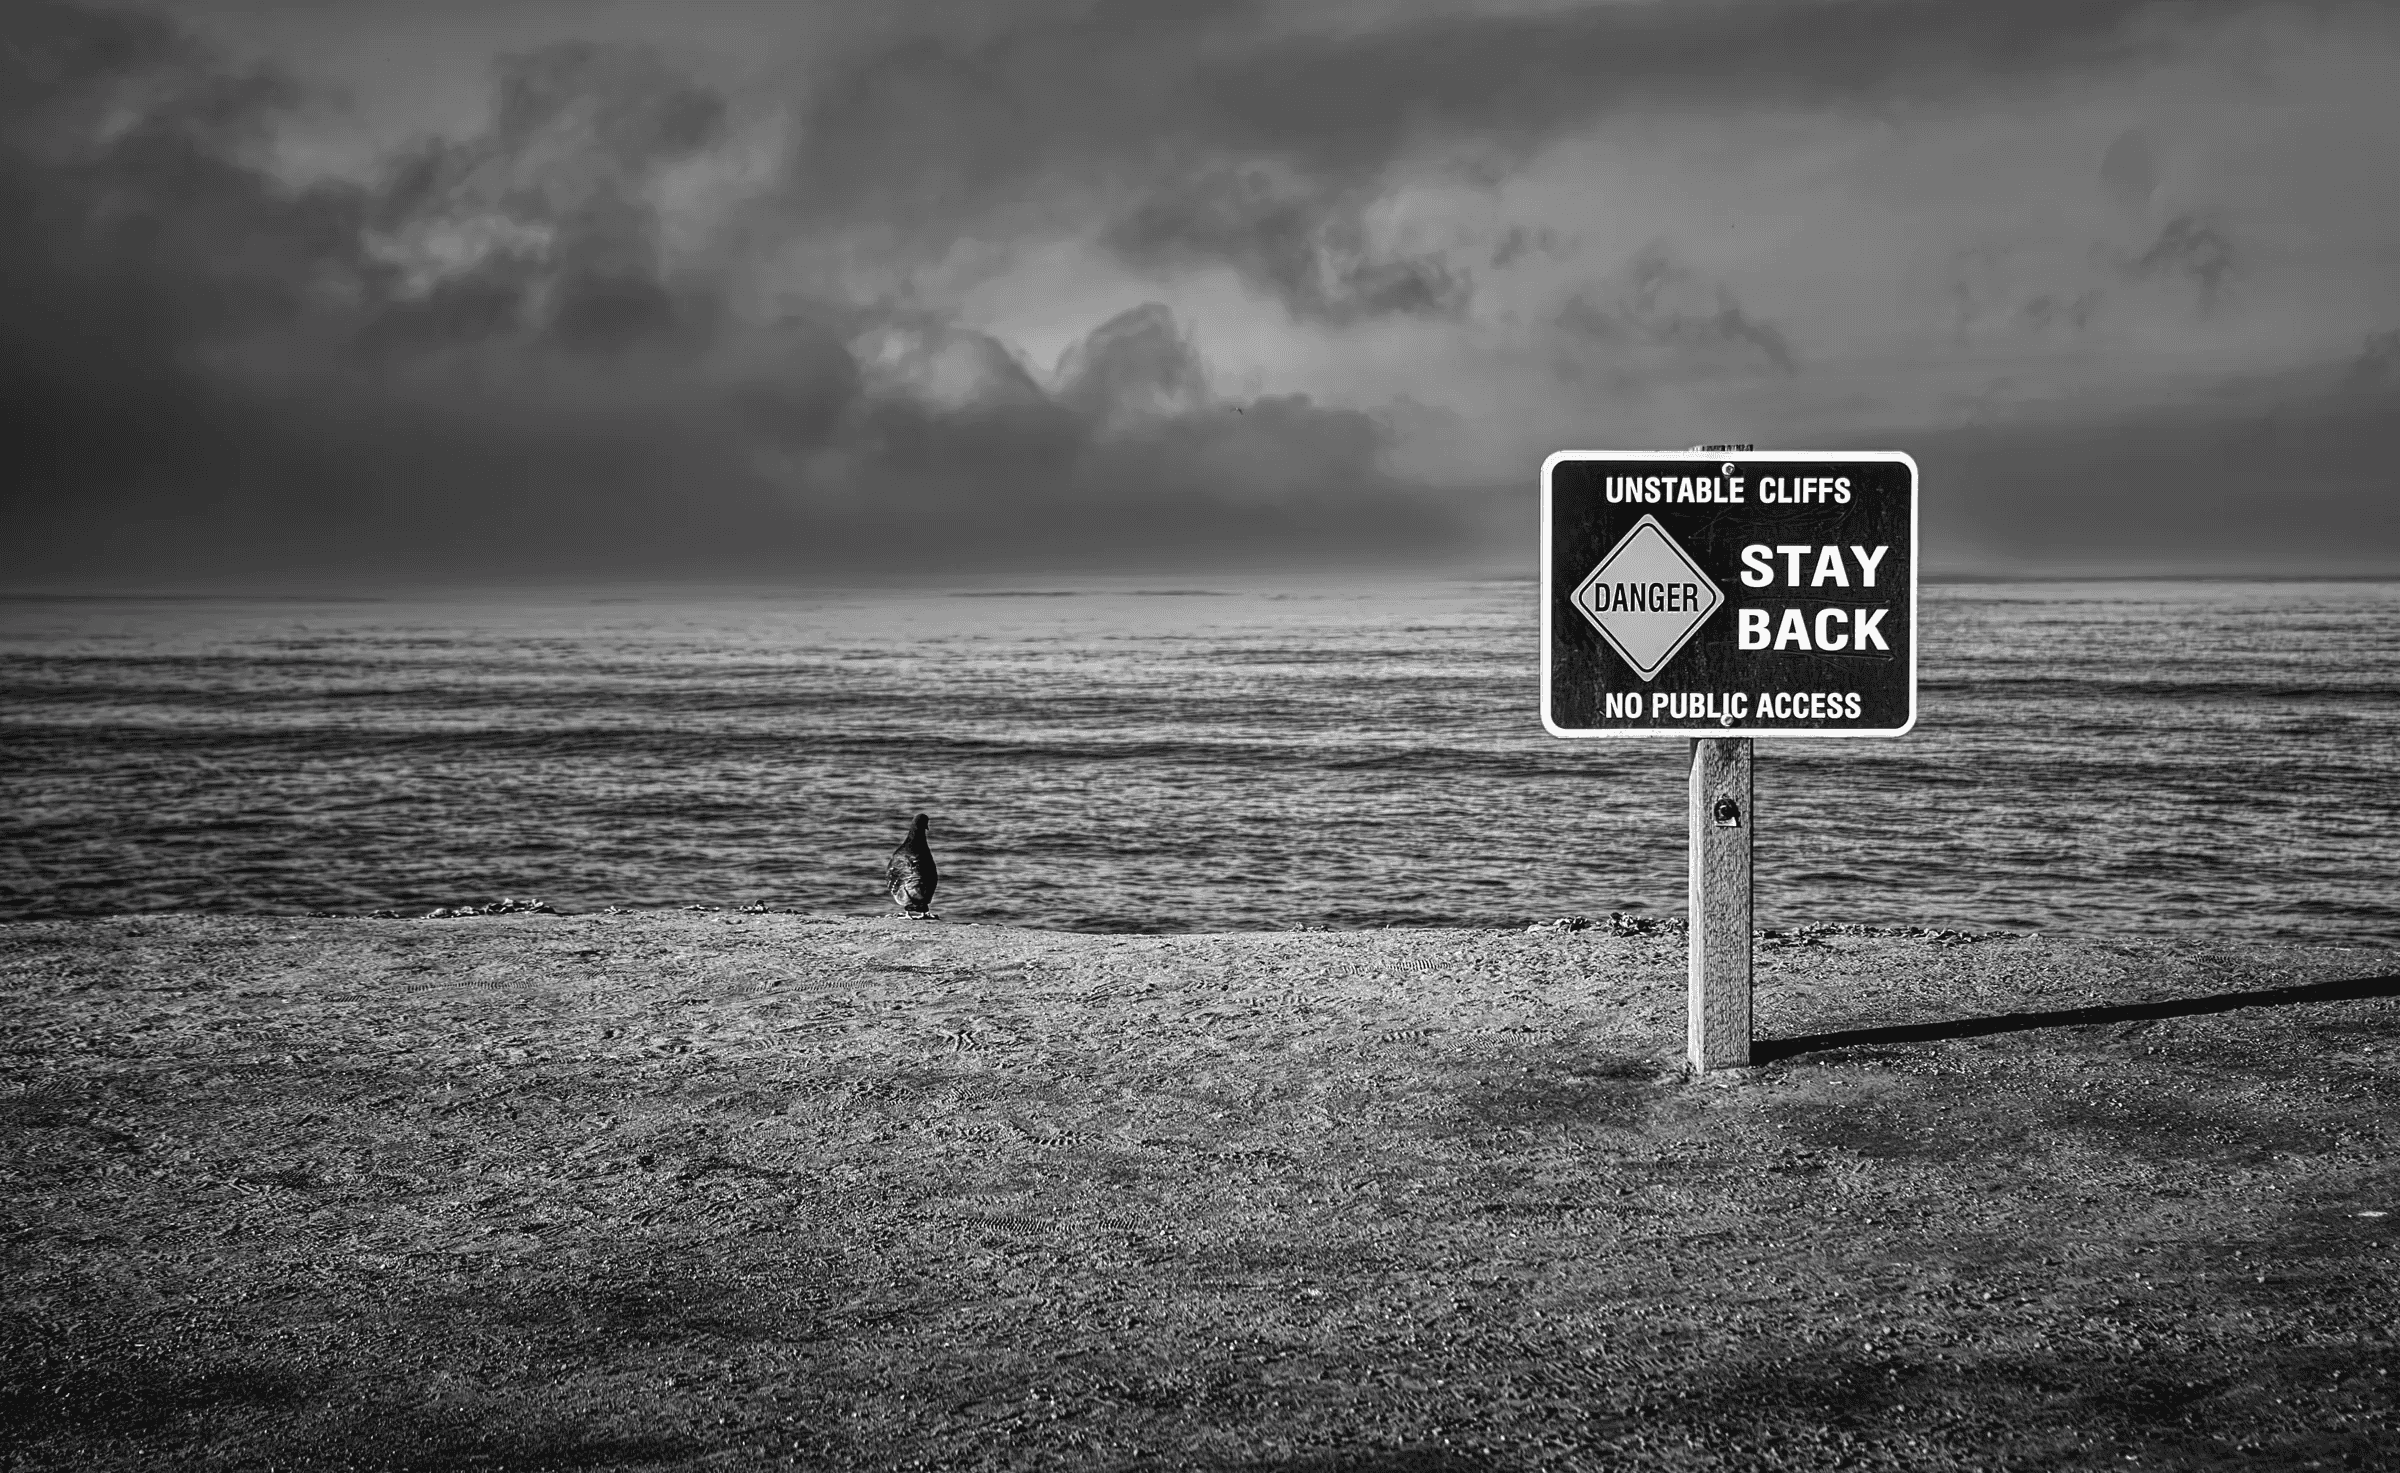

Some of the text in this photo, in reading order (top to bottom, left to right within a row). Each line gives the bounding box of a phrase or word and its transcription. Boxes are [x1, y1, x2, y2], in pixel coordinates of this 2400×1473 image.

[1606, 477, 1851, 503] UNSTABLE CLIFFS
[1740, 544, 1889, 588] STAY
[1595, 583, 1699, 612] DANGER
[1738, 608, 1889, 651] BACK
[1605, 693, 1862, 719] NO PUBLIC ACCESS
